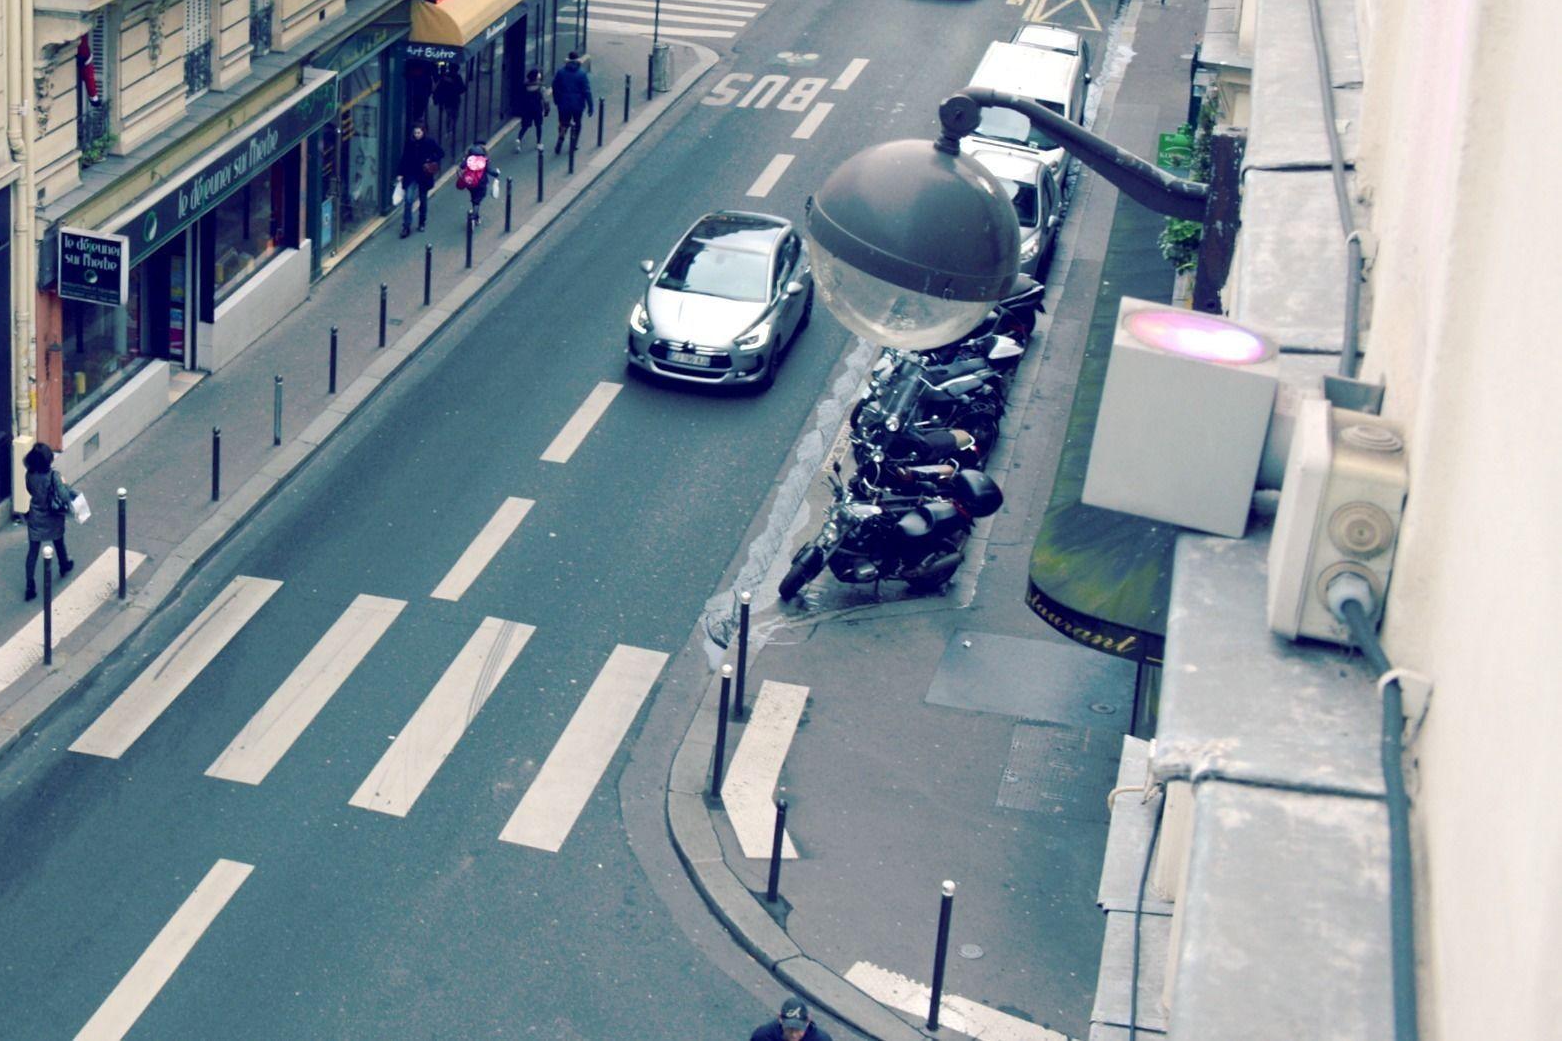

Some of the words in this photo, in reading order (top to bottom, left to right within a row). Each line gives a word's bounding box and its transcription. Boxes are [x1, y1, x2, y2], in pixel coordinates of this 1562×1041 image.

[407, 45, 424, 57] Art
[425, 47, 456, 59] Bistro
[700, 72, 829, 112] BUS
[179, 189, 188, 219] le
[190, 164, 232, 211] déjeuner
[234, 151, 248, 179] sur
[65, 235, 74, 248] le
[76, 237, 121, 256] déjeuner
[65, 254, 80, 265] sur
